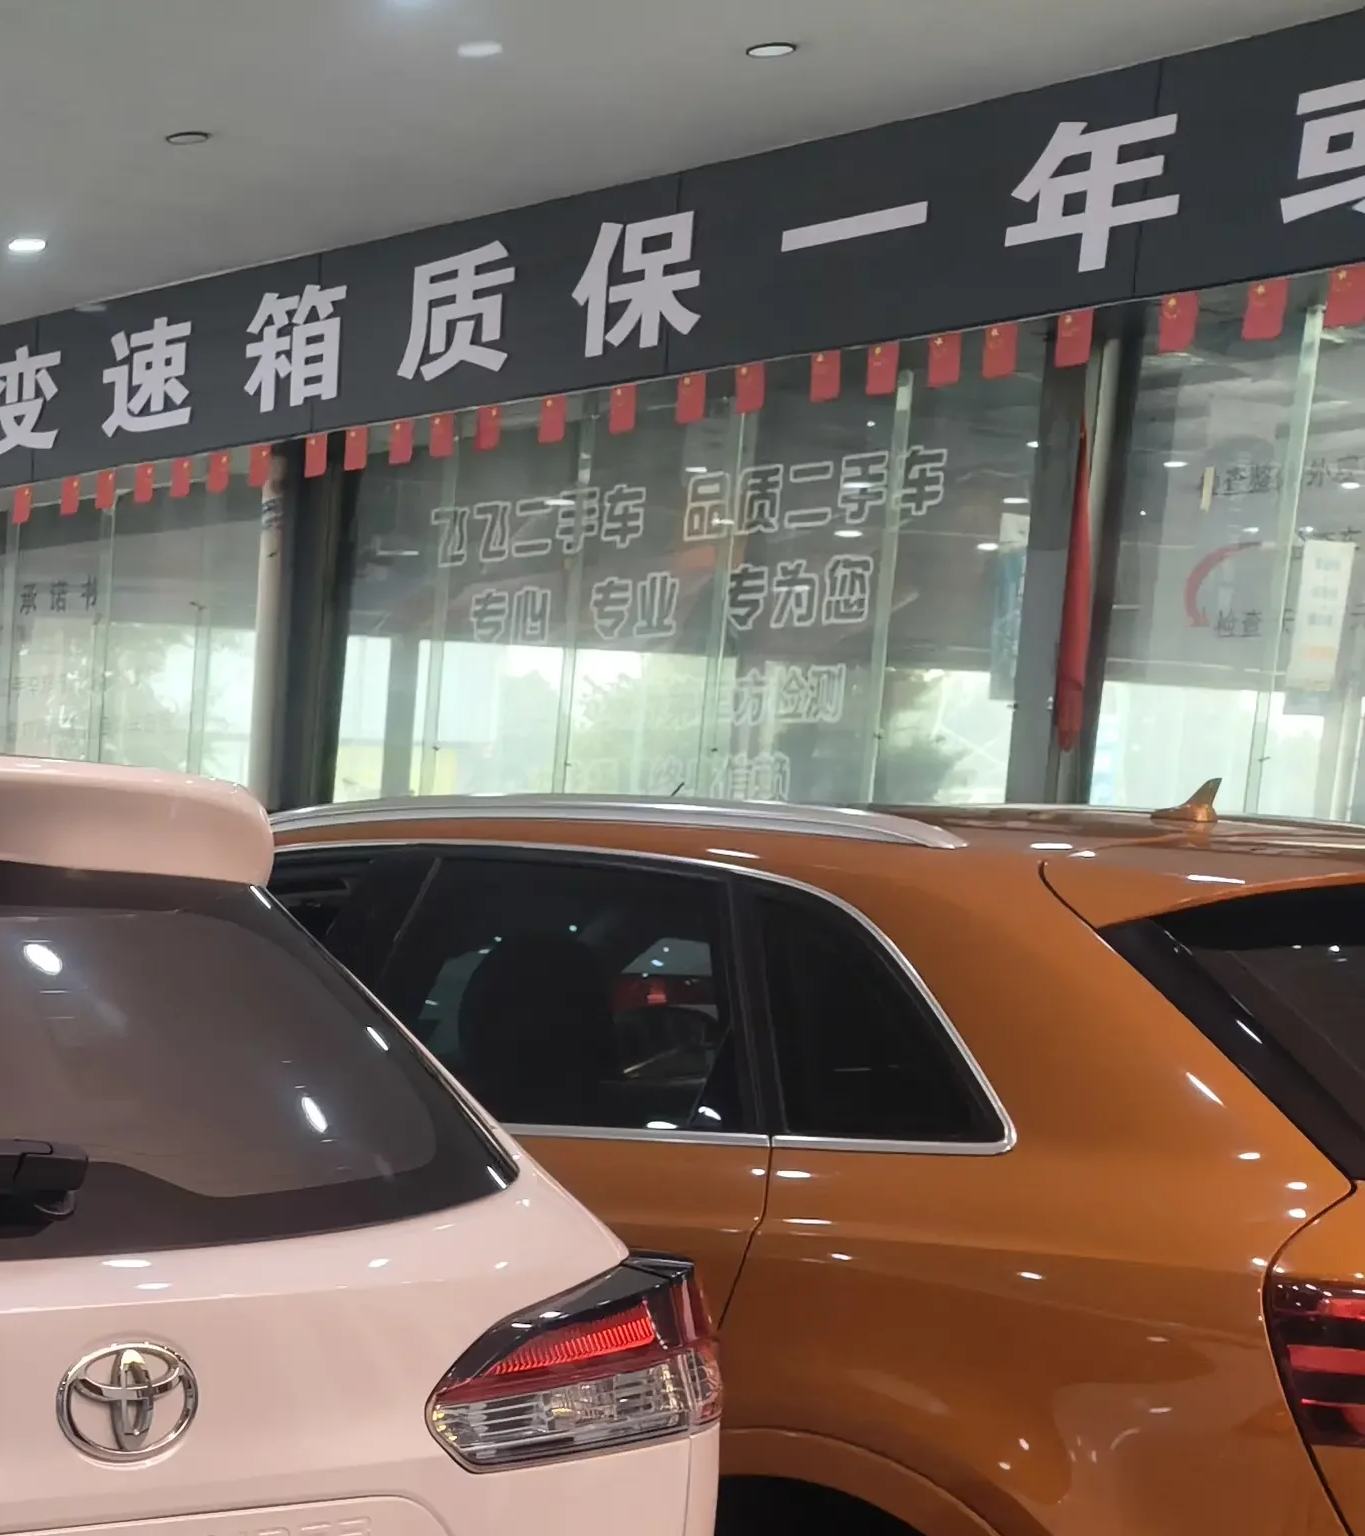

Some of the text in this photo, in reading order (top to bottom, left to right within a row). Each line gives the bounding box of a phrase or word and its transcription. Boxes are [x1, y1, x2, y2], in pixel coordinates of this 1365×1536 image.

[683, 445, 948, 541] 品质二手车
[471, 553, 874, 644] 专心 专业 专为您
